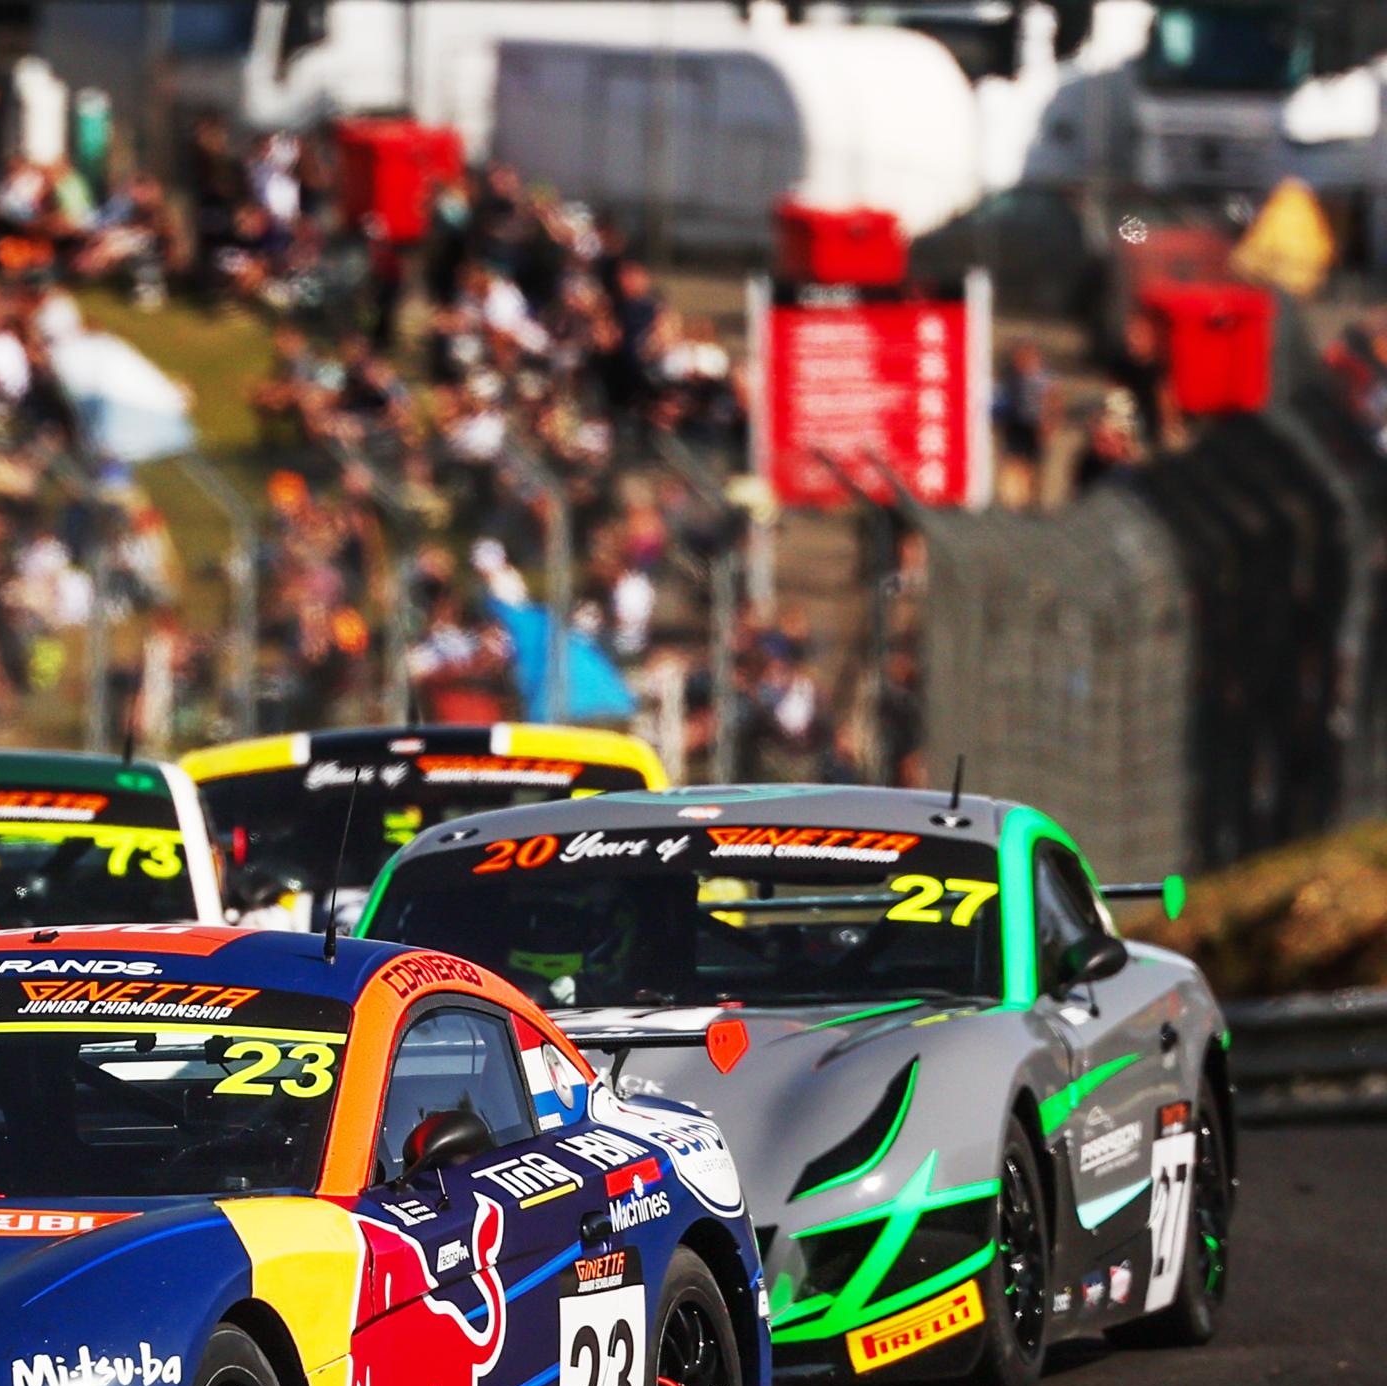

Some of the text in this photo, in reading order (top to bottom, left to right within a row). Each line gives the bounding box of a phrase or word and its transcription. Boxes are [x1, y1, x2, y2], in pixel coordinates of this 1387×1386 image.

[95, 834, 182, 880] 73
[472, 831, 691, 873] 20 Years of
[707, 827, 922, 854] GINETTA
[886, 874, 1000, 926] 27
[17, 1000, 235, 1021] JUNIOR CHAMPIONSHIP
[19, 980, 262, 1010] GINETTA
[213, 1040, 336, 1099] 23
[556, 1129, 649, 1171] HBM
[609, 1191, 671, 1233] Machines
[575, 1252, 625, 1281] GINETTA
[860, 1294, 971, 1360] PIRELLI
